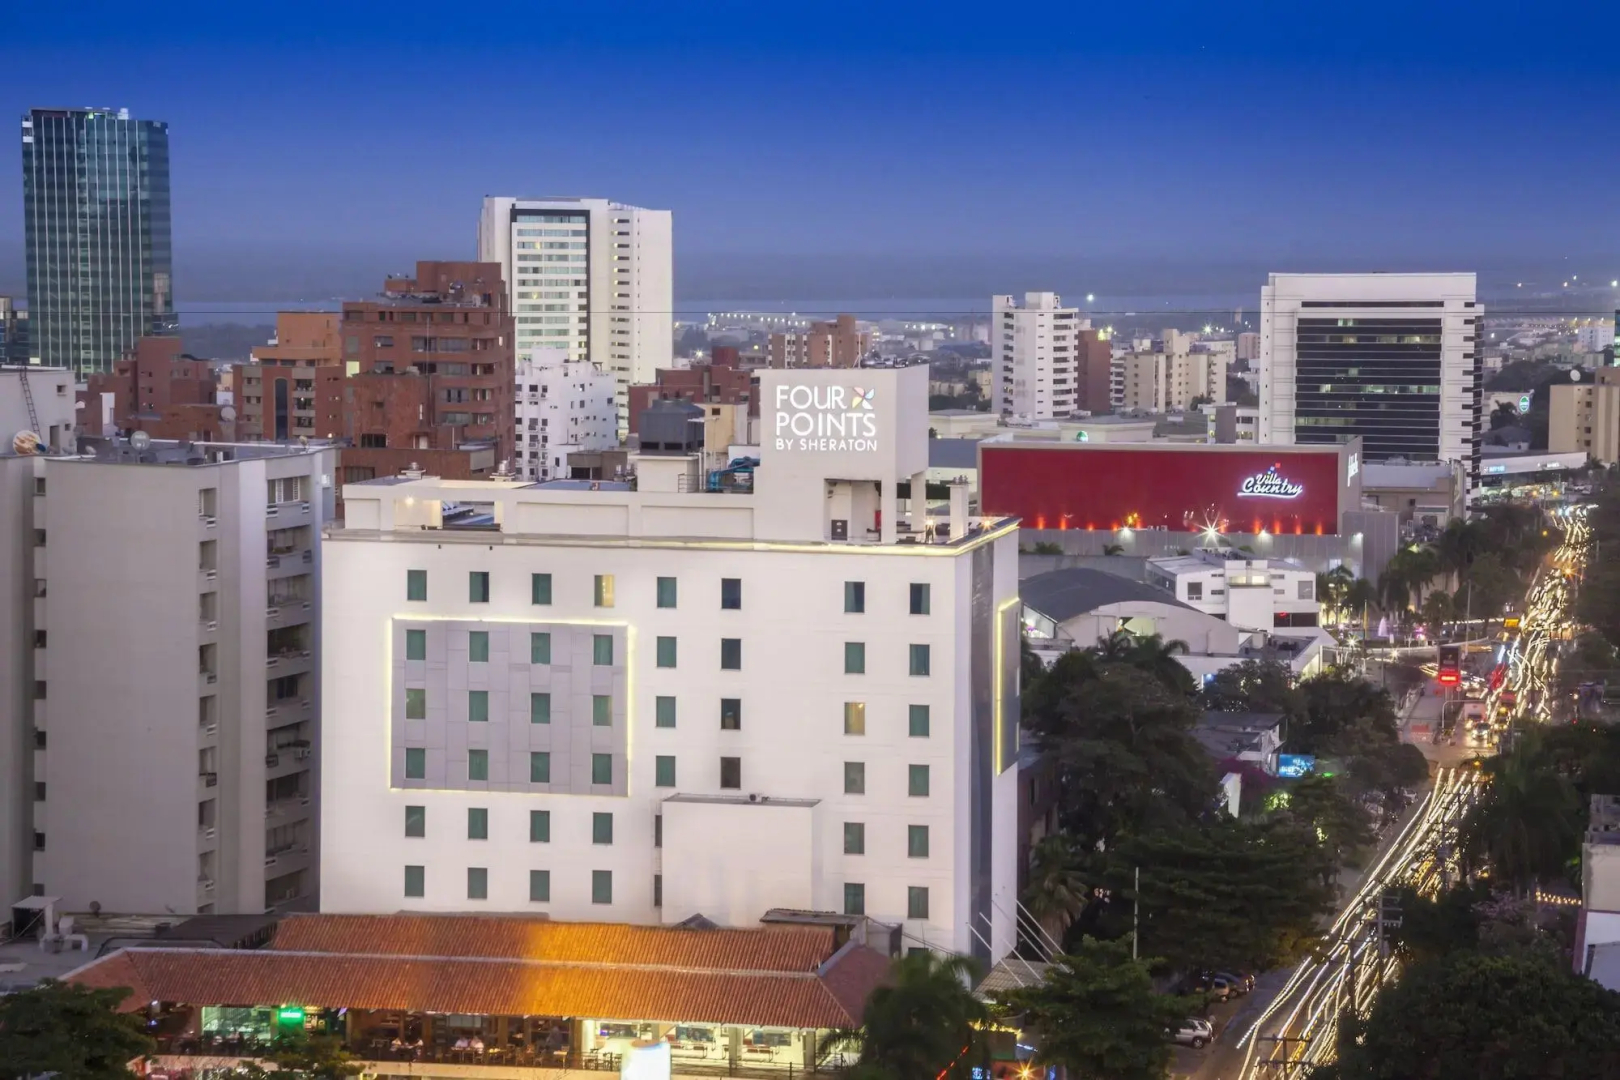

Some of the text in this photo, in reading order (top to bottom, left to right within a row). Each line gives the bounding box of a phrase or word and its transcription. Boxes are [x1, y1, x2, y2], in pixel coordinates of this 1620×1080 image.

[776, 385, 847, 410] FOUR
[776, 412, 876, 437] POINTS
[776, 438, 877, 451] BY SHERATON
[1242, 477, 1303, 495] Country
[1256, 473, 1282, 485] Villa
